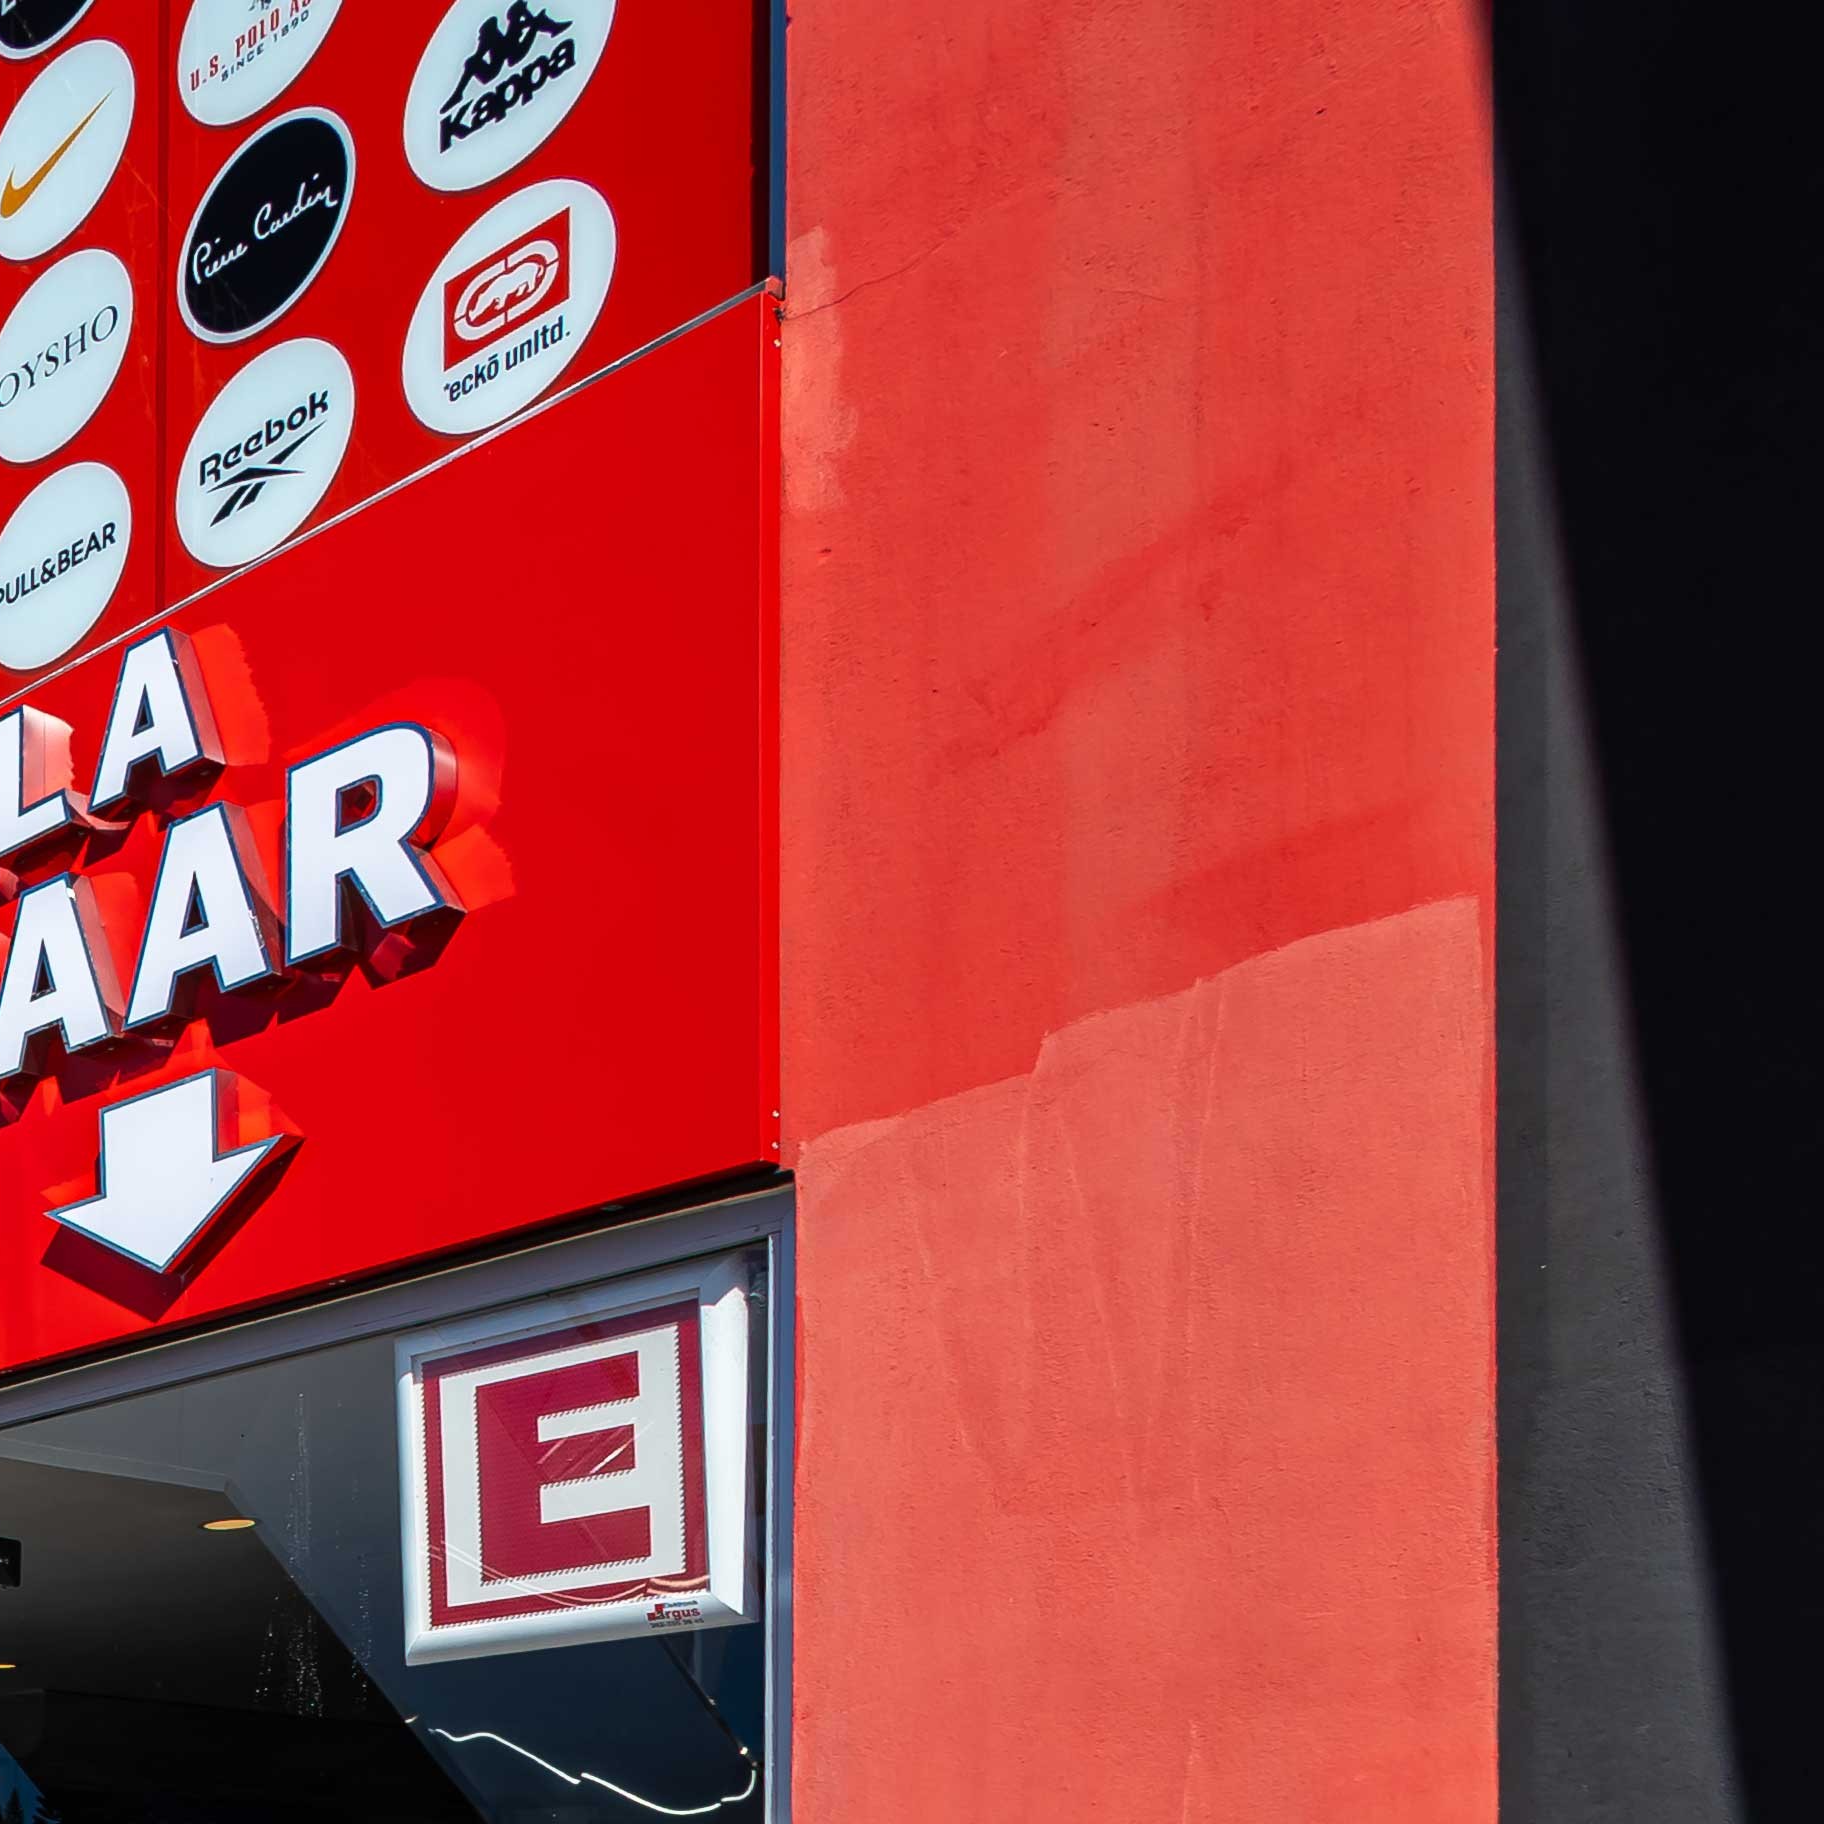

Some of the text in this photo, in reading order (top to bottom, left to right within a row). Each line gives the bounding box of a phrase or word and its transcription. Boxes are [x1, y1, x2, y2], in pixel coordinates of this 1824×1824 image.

[221, 10, 311, 81] SINCE 1890
[235, 8, 280, 59] POLO
[200, 390, 329, 487] Reebok
